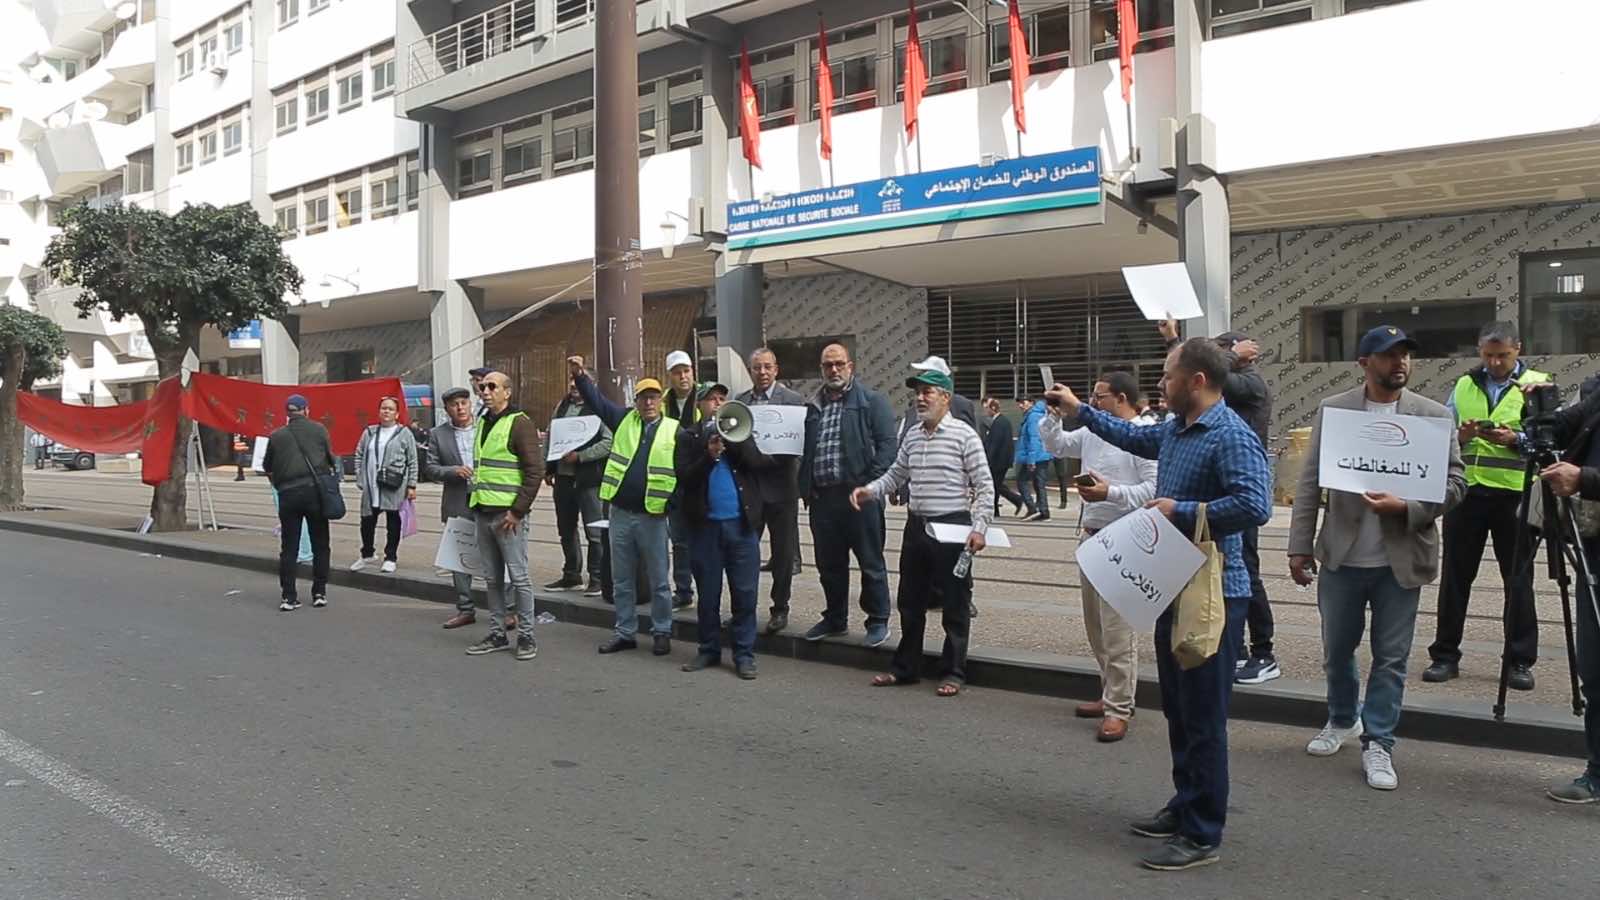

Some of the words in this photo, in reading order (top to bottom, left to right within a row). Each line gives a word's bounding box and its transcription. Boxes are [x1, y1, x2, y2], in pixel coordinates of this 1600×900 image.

[1012, 167, 1047, 188] الوطني
[1049, 160, 1095, 183] الصندوق
[972, 172, 1010, 191] للضمان
[729, 221, 750, 232] CAISSE
[752, 215, 784, 229] NATIONALE
[787, 213, 796, 223] DE
[831, 204, 859, 217] SOCIALE
[1494, 228, 1518, 246] BOND
[1329, 370, 1351, 386] BOND
[1336, 456, 1411, 477] للمغالطات
[1416, 464, 1430, 479] لا
[1109, 553, 1122, 565] هو
